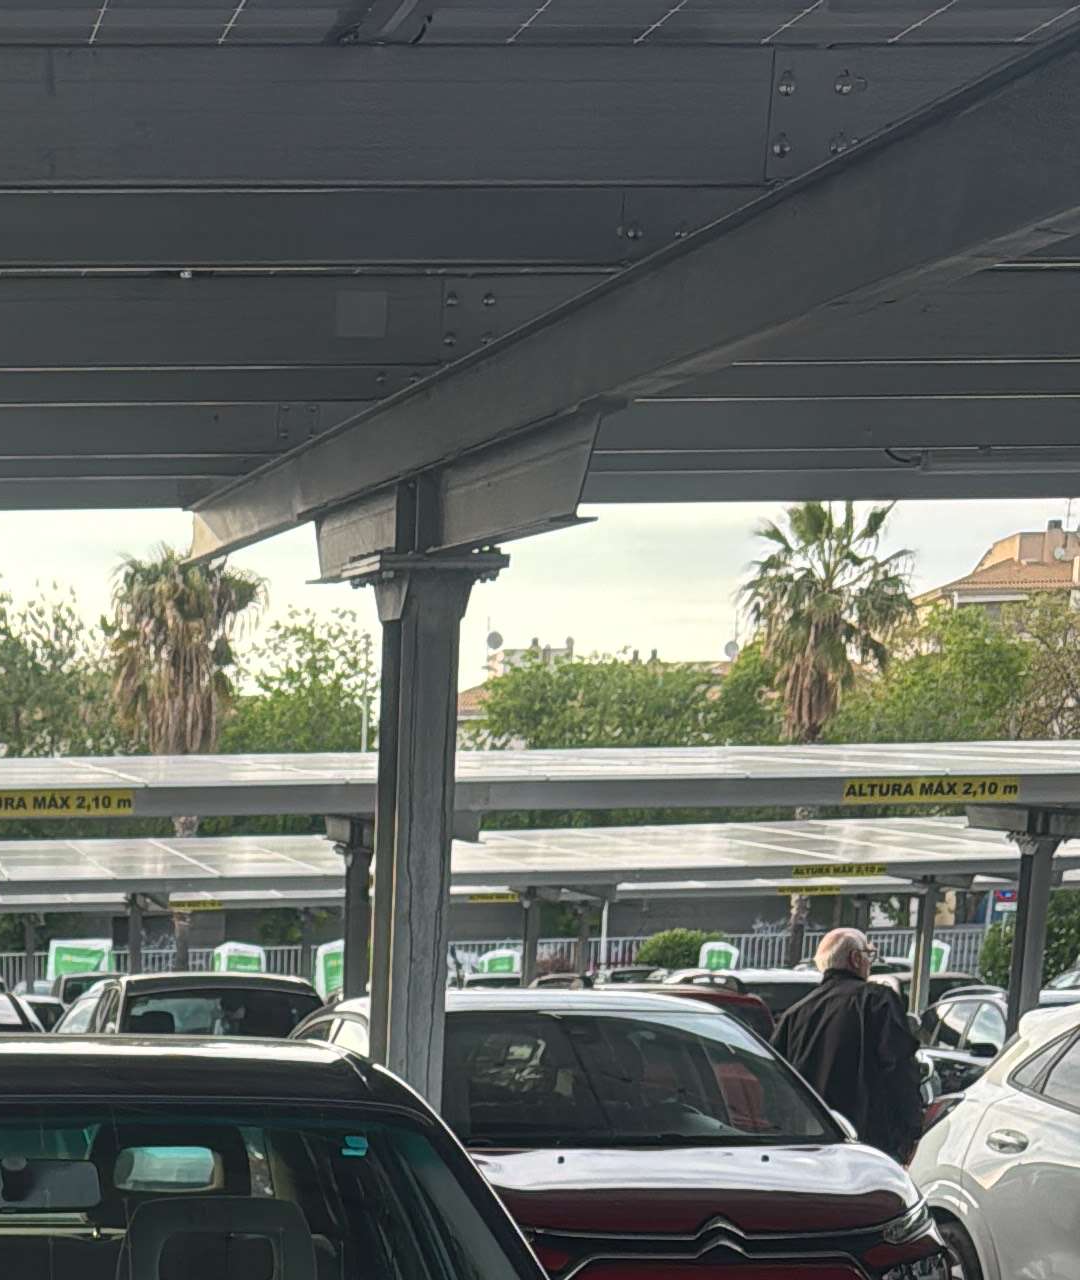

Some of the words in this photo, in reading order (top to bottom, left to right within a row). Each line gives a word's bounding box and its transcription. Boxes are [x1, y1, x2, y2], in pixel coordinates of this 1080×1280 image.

[846, 783, 914, 797] ALTURA
[962, 782, 998, 798] 2,10
[1003, 784, 1018, 794] m
[76, 796, 111, 811] 2,10
[117, 798, 132, 809] m
